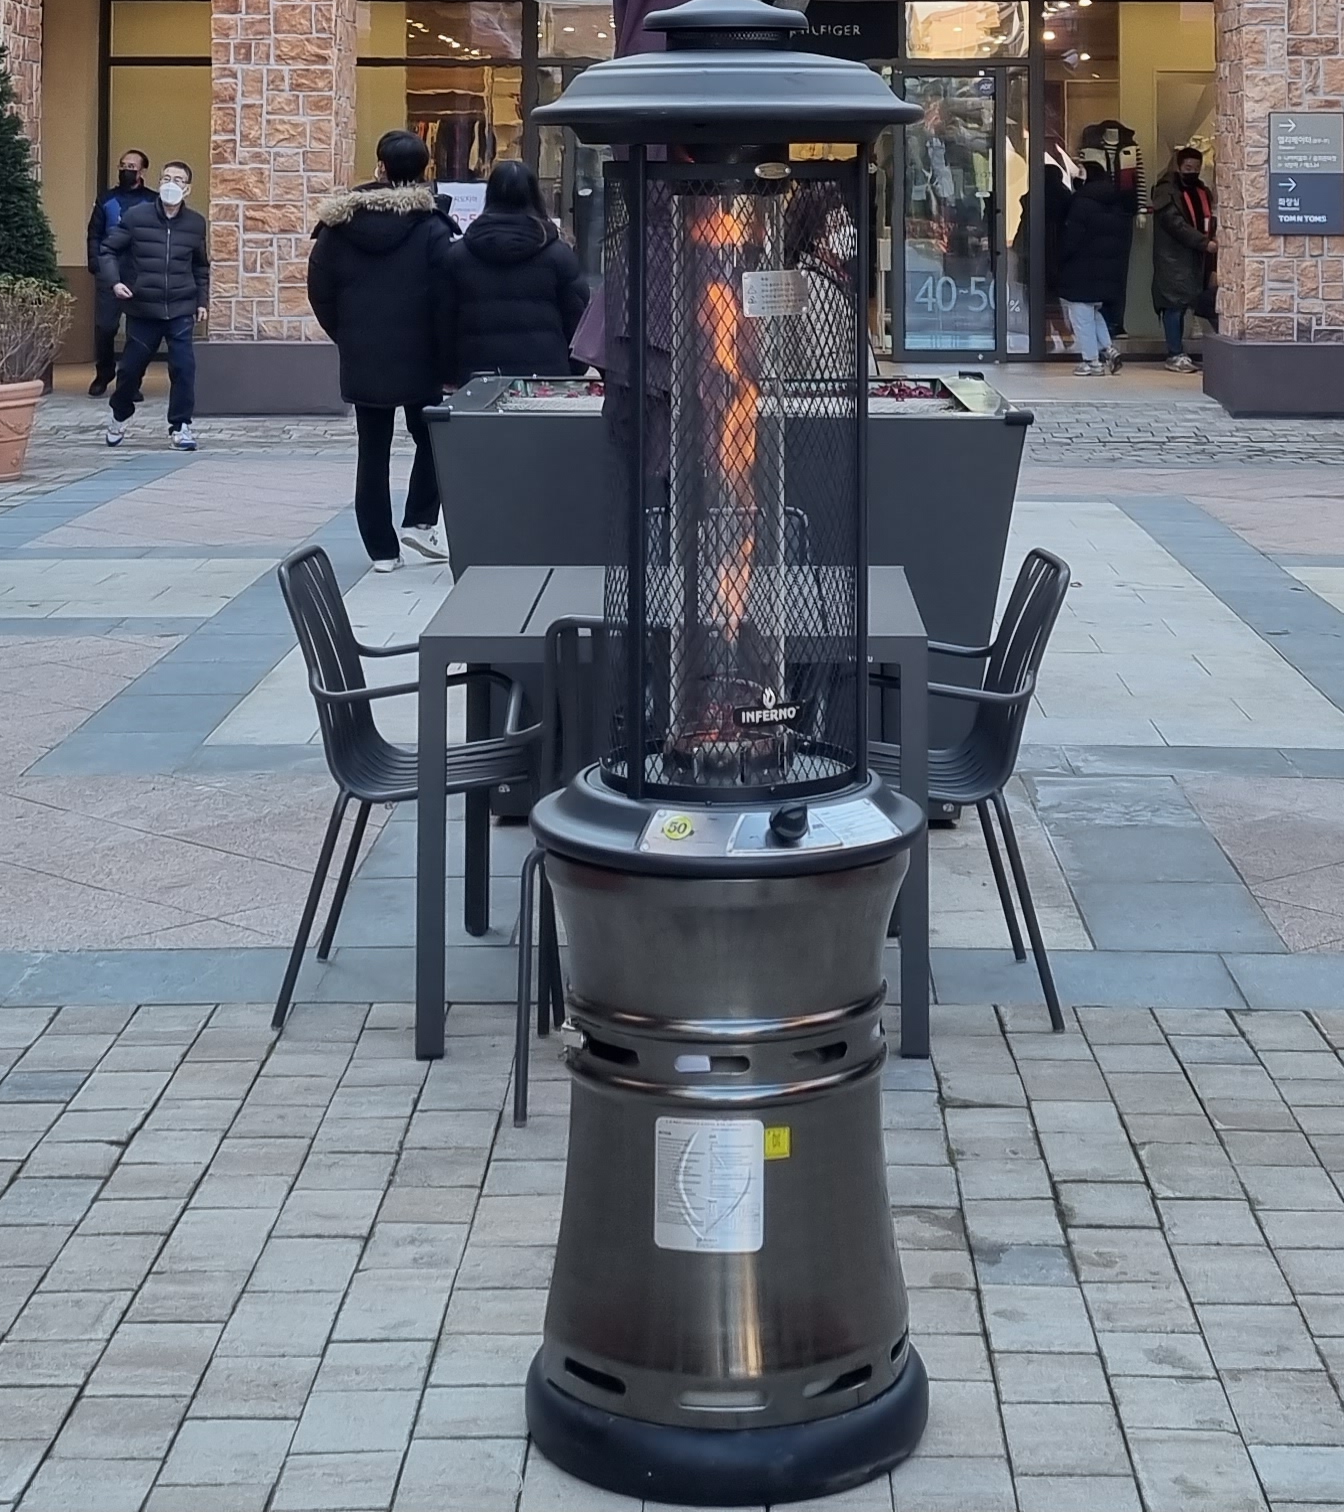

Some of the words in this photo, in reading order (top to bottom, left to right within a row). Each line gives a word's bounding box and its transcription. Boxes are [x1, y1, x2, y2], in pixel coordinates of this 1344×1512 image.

[1278, 198, 1300, 207] 화장실
[741, 706, 797, 724] INFERNO
[667, 820, 689, 835] 50
